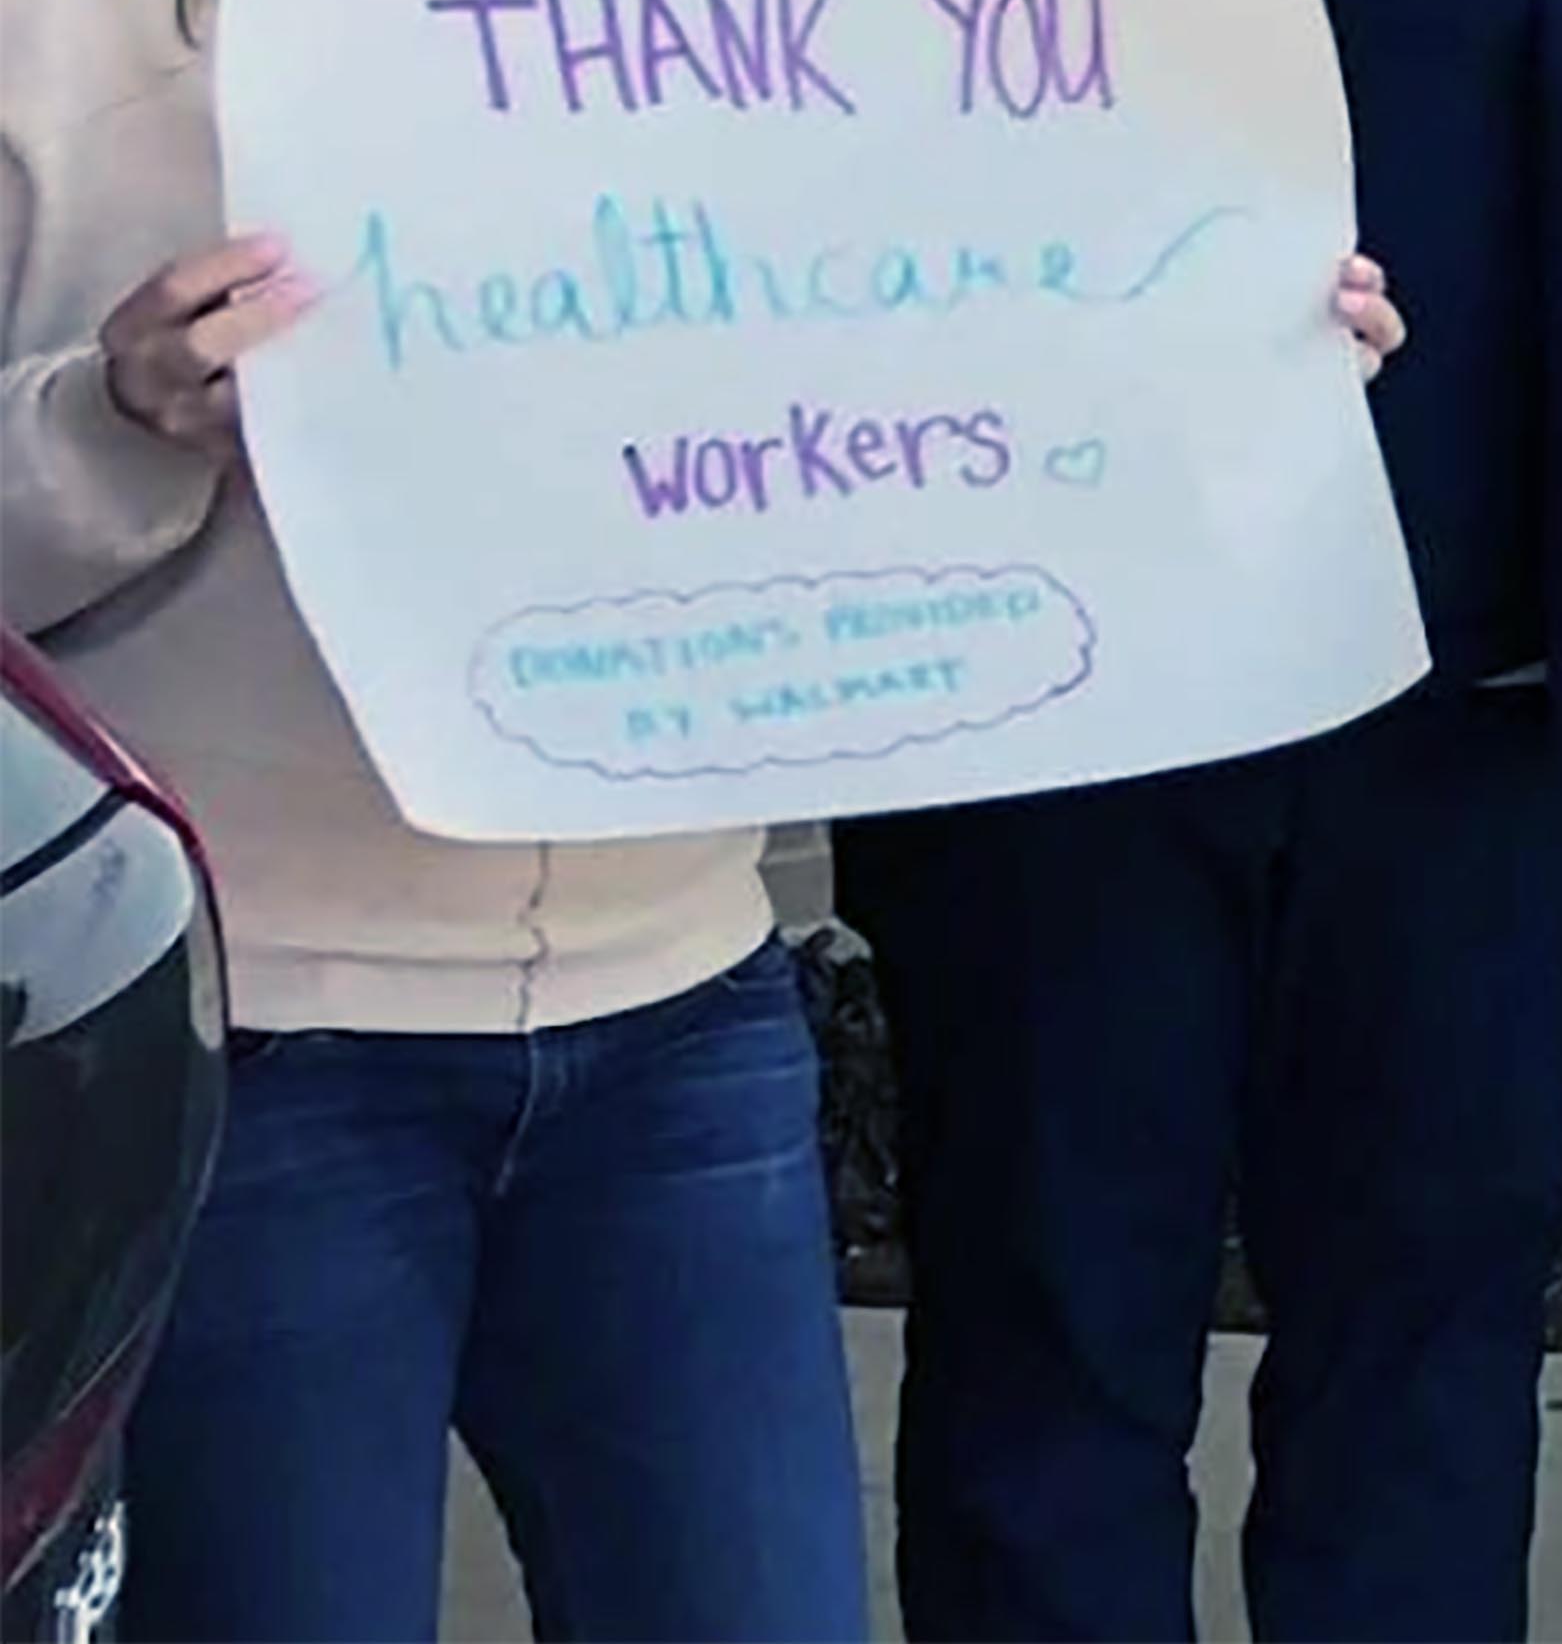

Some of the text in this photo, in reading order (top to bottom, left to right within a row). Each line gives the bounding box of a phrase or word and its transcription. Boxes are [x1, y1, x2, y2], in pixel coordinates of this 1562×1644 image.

[316, 194, 1252, 369] healthcare
[622, 403, 1012, 518] workers
[727, 655, 966, 723] WALMART
